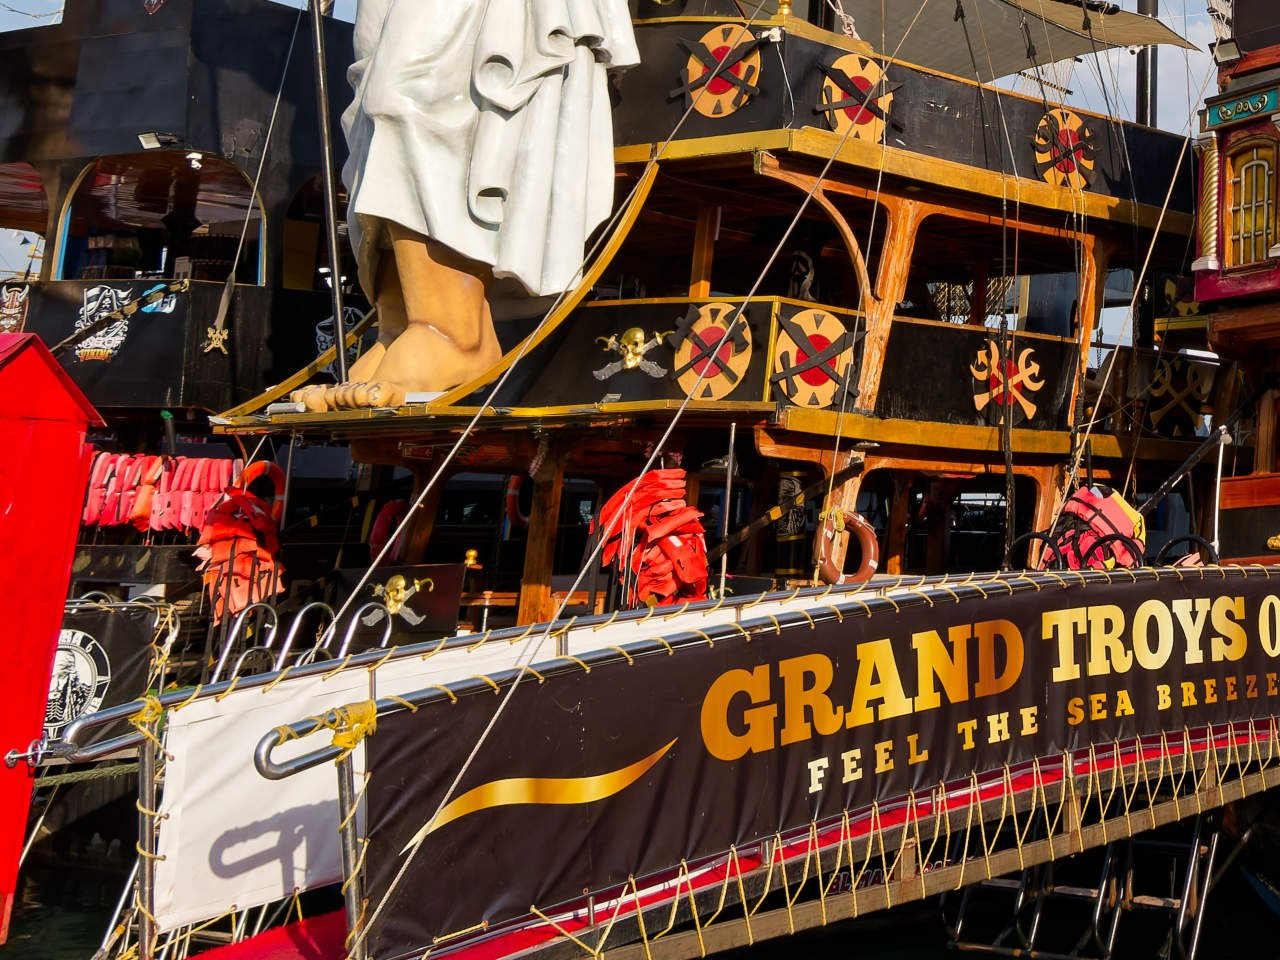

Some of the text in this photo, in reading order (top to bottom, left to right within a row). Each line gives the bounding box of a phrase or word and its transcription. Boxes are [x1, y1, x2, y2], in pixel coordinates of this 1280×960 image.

[701, 619, 1024, 761] GRAND
[1041, 595, 1247, 682] TROYS
[808, 673, 1278, 793] FEEL THE SEA BREEZE
